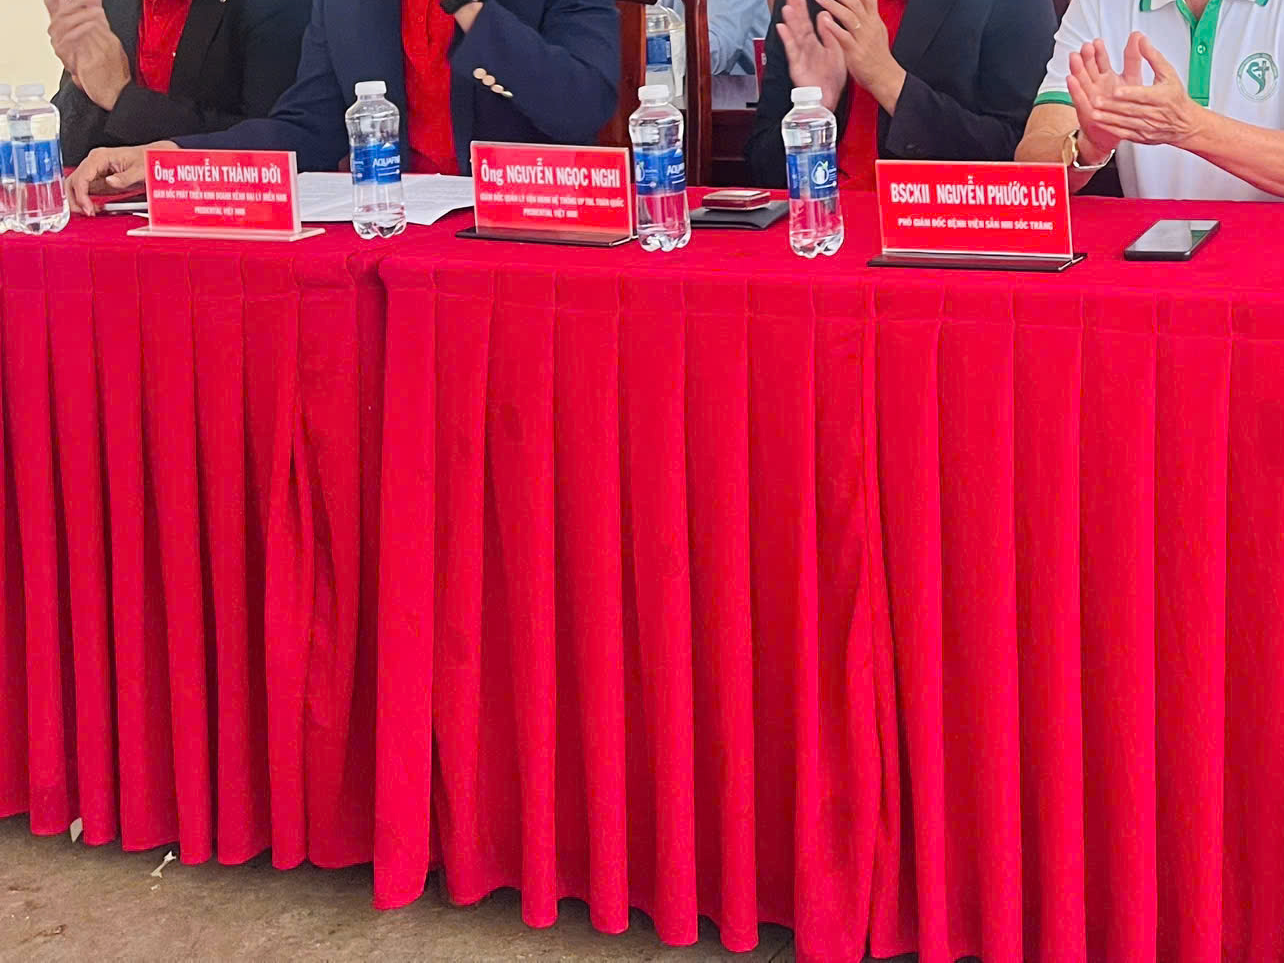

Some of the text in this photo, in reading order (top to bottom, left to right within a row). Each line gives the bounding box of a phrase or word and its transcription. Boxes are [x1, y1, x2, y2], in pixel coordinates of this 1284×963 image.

[154, 160, 175, 184] Ông
[177, 158, 220, 182] NGUYỄN
[221, 163, 259, 183] THÀNH
[481, 159, 504, 185] Ông
[506, 157, 554, 185] NGUYỄN
[556, 167, 589, 189] NGỌC
[591, 168, 621, 187] NGHI
[890, 175, 1056, 210] BSCKII NGUYỄN PHƯỚC LỘC
[898, 216, 912, 227] PHÓ
[968, 218, 984, 229] VIỆN
[1014, 218, 1029, 229] SÓC
